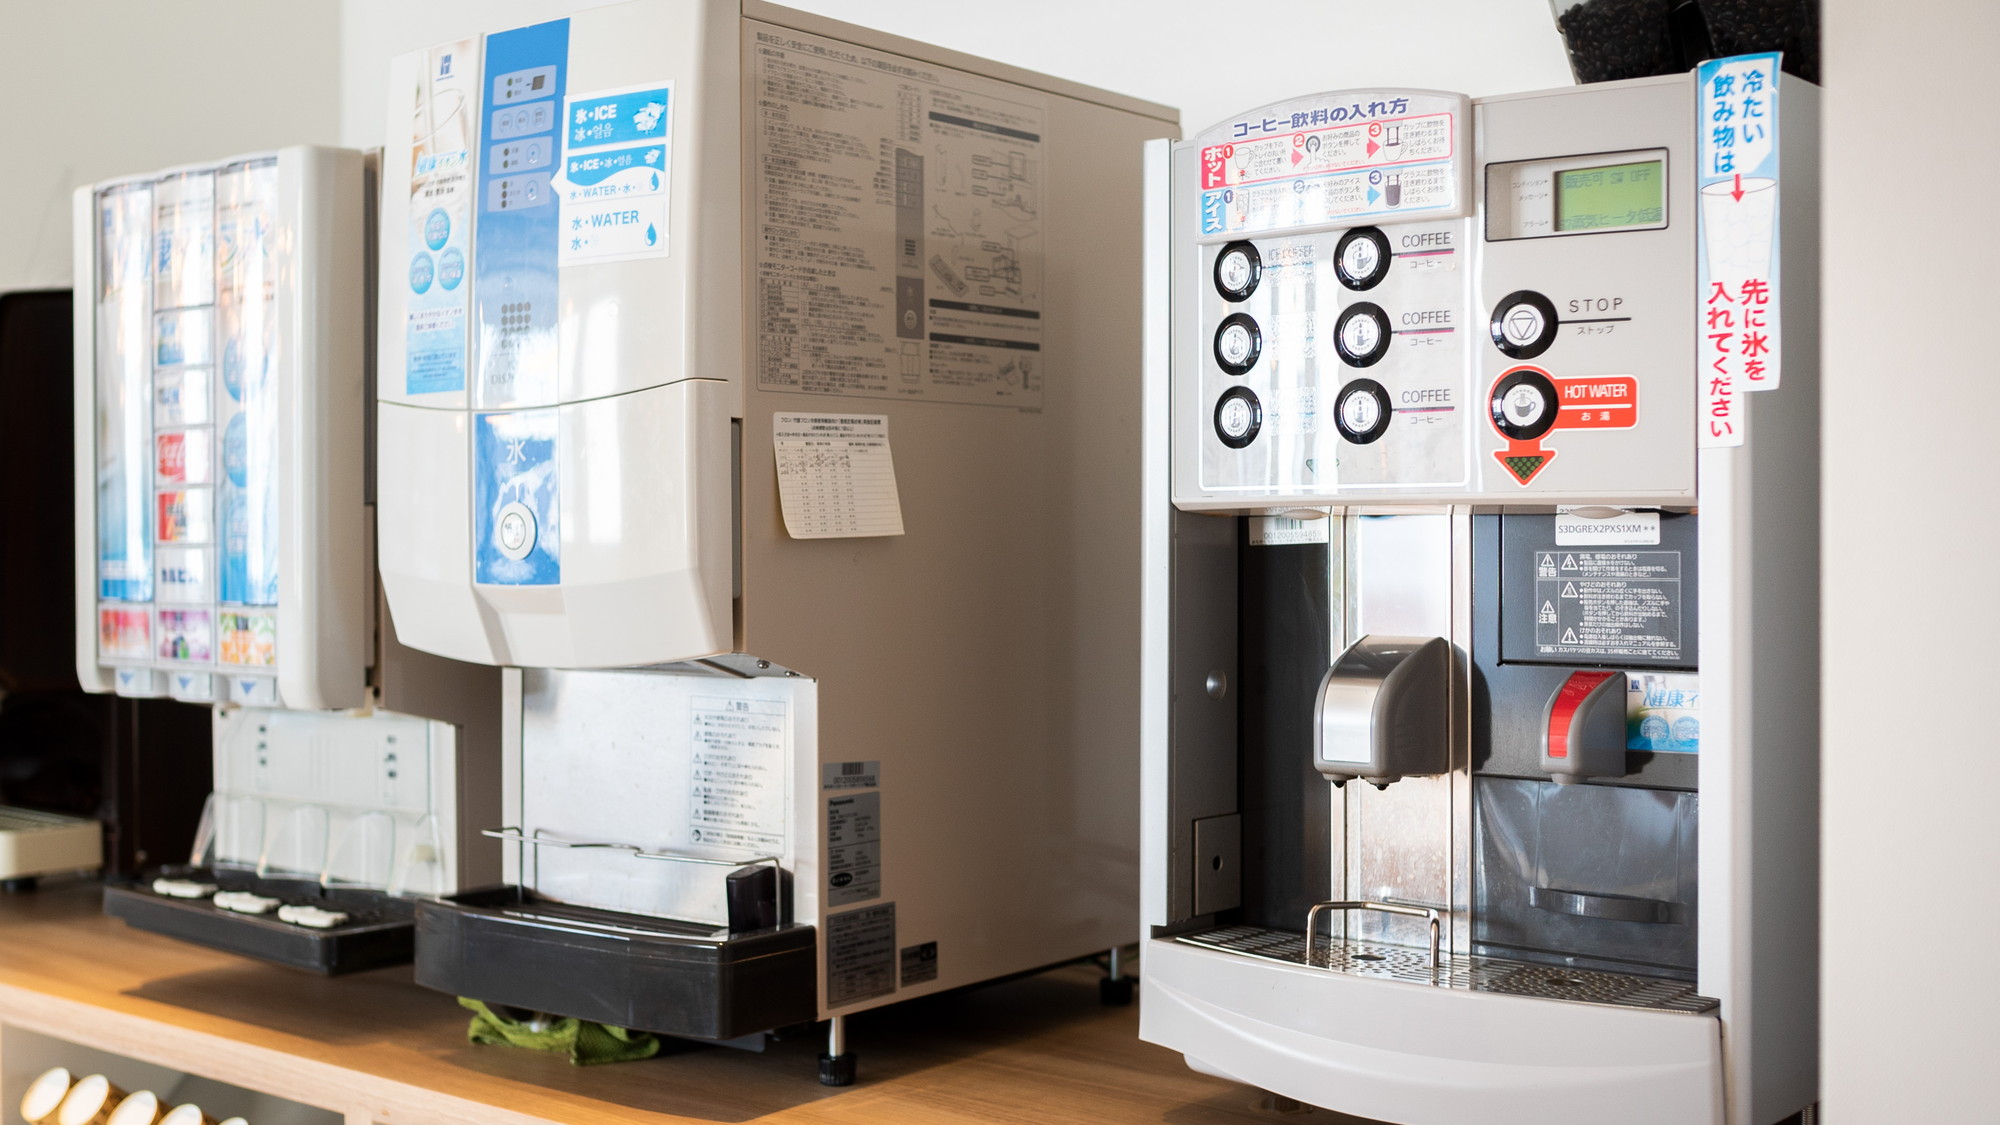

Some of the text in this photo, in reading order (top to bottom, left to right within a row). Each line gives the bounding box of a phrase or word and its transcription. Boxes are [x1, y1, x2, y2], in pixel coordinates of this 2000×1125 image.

[1741, 69, 1765, 143] 冷たい
[1233, 98, 1409, 137] コーヒー飲料の入れ方
[1712, 74, 1735, 174] 飲み物は
[1204, 147, 1223, 187] ホット
[1205, 191, 1223, 232] アイス
[1402, 231, 1451, 248] COFFEE
[1410, 260, 1442, 269] コーヒー
[1569, 297, 1624, 313] STOP
[1402, 310, 1451, 326] COFFEE
[1576, 325, 1616, 335] ストップ
[1740, 278, 1770, 381] 先に氷を
[1410, 338, 1443, 347] コーヒー
[1707, 281, 1735, 438] 入れてください
[1402, 388, 1451, 404] COFFEE
[1564, 383, 1628, 399] HOT WATER
[1410, 416, 1443, 425] コーヒー
[506, 438, 527, 465] 氷
